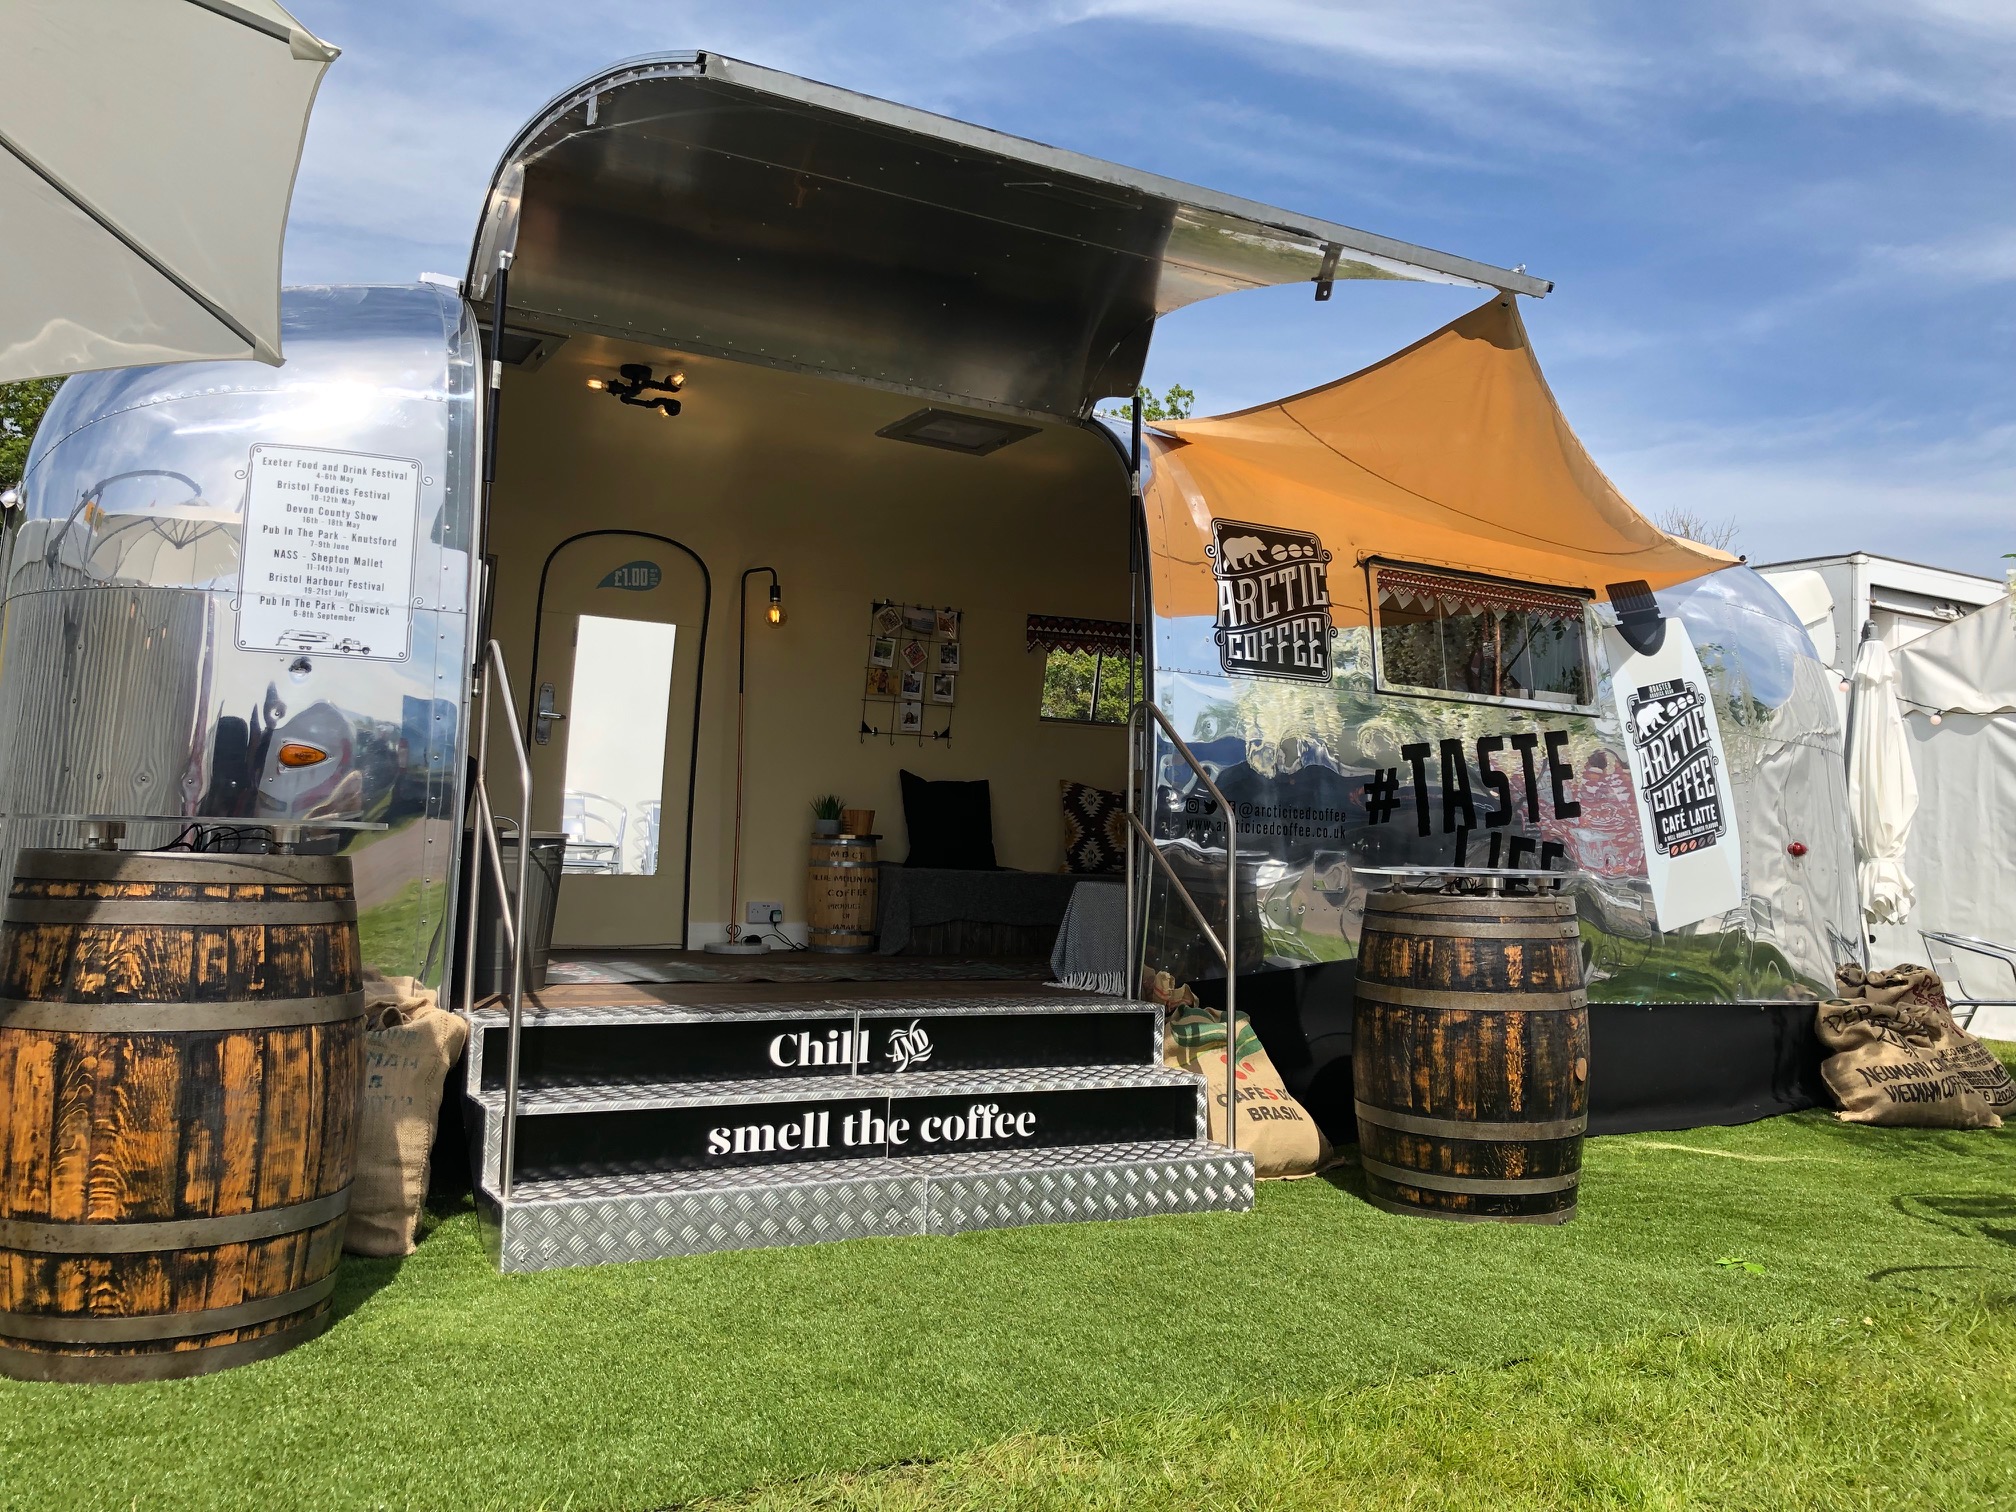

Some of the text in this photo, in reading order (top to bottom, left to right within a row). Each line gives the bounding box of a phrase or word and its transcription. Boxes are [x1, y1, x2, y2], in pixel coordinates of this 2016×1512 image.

[262, 457, 408, 481] Exeter Food and Drink Festival
[316, 472, 354, 484] 4-6th May
[277, 480, 391, 501] Bristol Foodies Festival
[311, 494, 356, 507] 10-12th May
[286, 503, 378, 522] Devon County Show
[302, 516, 319, 524] 16th
[328, 519, 344, 527] 18th
[346, 521, 361, 530] May
[262, 524, 280, 535] Pub
[284, 526, 293, 536] In
[297, 527, 314, 538] The
[318, 529, 339, 540] Park
[351, 533, 397, 547] Knutsford
[310, 540, 350, 551] 7-9th June
[273, 549, 298, 560] NASS
[311, 552, 350, 567] Shepton
[353, 556, 383, 569] Mallet
[306, 563, 350, 575] 11-14th July
[268, 572, 385, 592] Bristol Harbour Festival
[614, 568, 648, 586] £1.00
[304, 587, 349, 598] 19-21st July
[1214, 562, 1331, 628] ARCTIC
[259, 596, 277, 606] Pub
[281, 597, 290, 607] In
[294, 598, 311, 608] The
[315, 600, 336, 610] Park
[349, 603, 390, 616] Chiswick
[293, 610, 356, 622] 6-8th September
[1227, 618, 1325, 669] COFFEE
[1637, 705, 1711, 788] ARCTIC
[1364, 730, 1582, 837] #TASTE
[1652, 756, 1717, 812] COFFEE
[1239, 802, 1346, 822] @arcticicedcoffee
[1662, 804, 1718, 835] CAFÉ LATTE
[1186, 818, 1346, 840] www.articicedcoffee.co.uk
[827, 888, 868, 898] COFFEE
[768, 1030, 870, 1068] Chill
[1856, 1061, 1932, 1087] NEUMANN
[1884, 1080, 1941, 1104] VIETNAM
[1246, 1106, 1304, 1122] BRASIL
[708, 1103, 1036, 1156] smell the coffee
